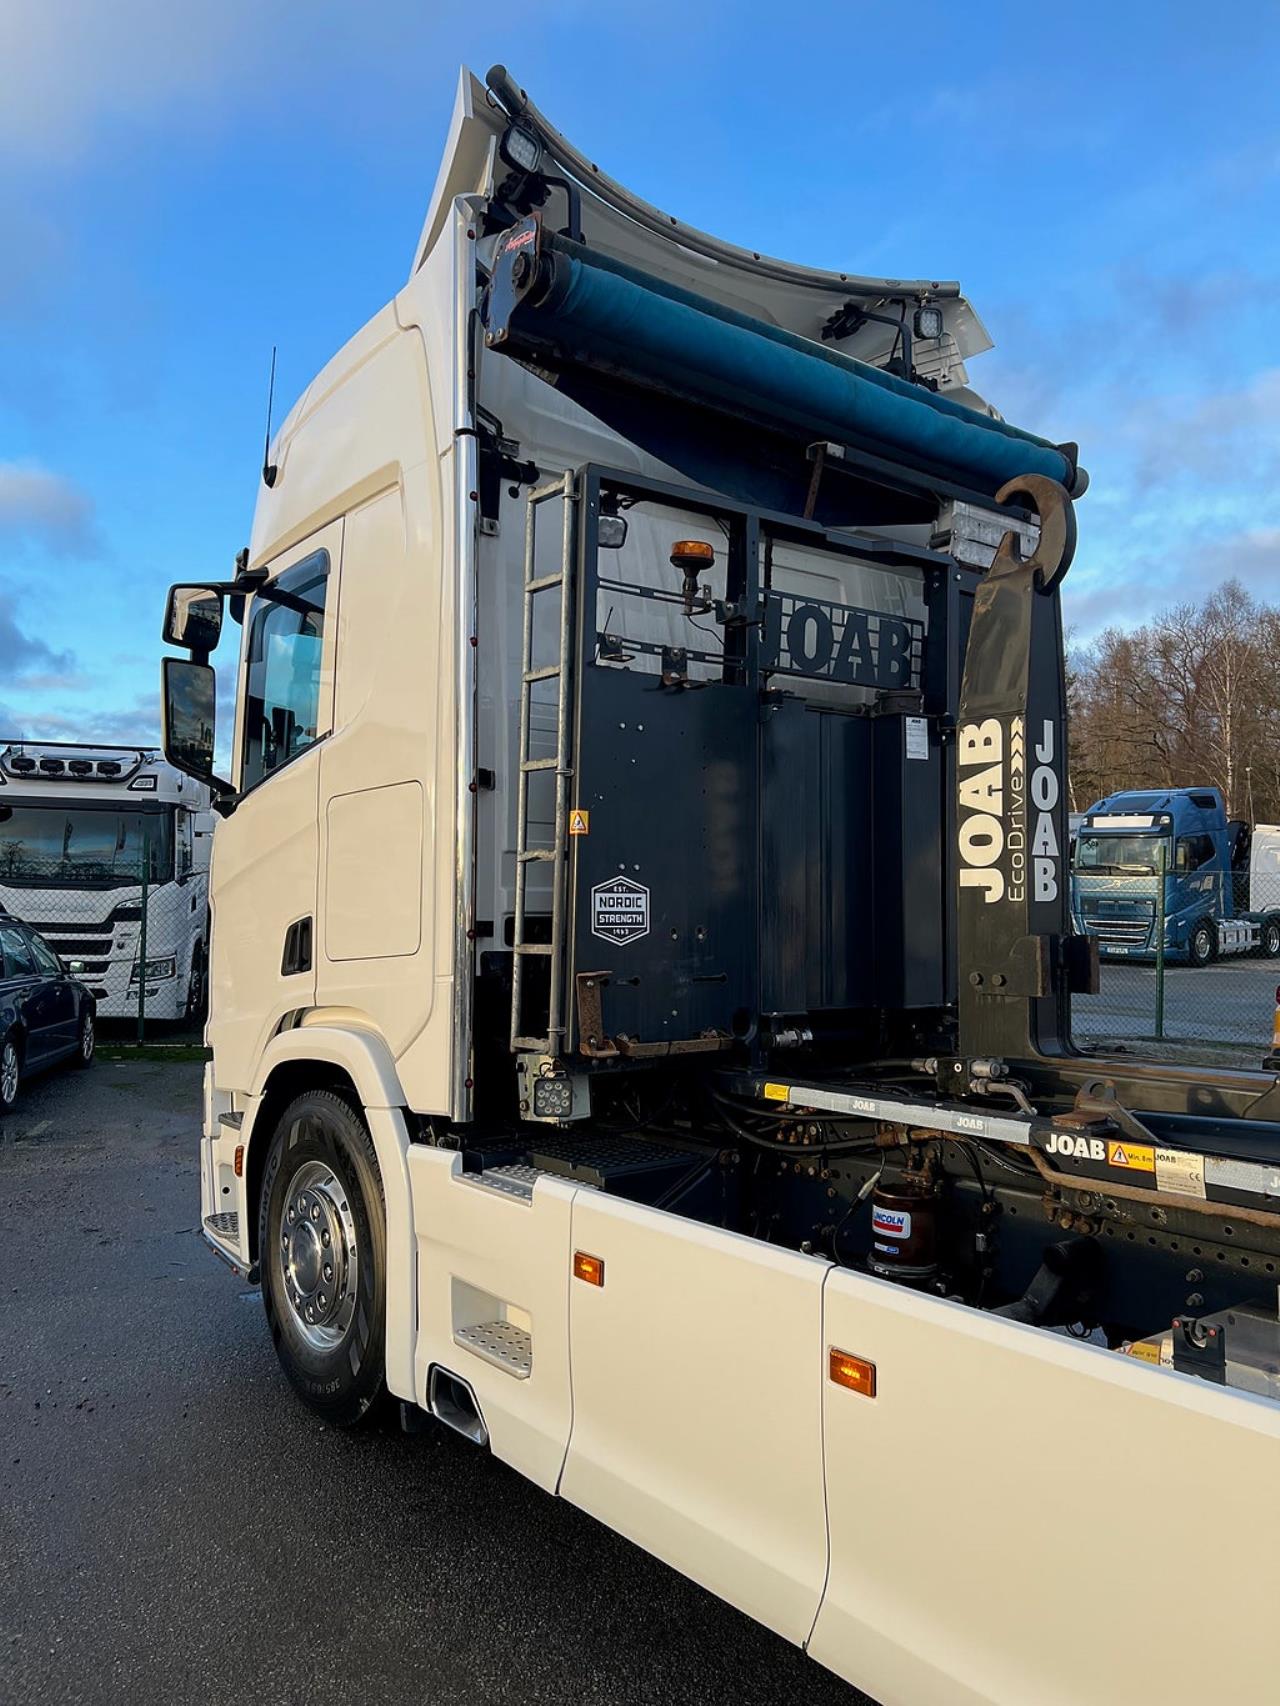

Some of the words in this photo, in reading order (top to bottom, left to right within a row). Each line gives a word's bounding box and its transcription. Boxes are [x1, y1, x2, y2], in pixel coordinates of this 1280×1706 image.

[759, 598, 911, 688] JOAB
[958, 718, 1004, 903] JOAB
[1031, 719, 1060, 902] JOAB
[1008, 775, 1024, 902] EcoDrive
[599, 896, 642, 908] NORDIC
[599, 914, 643, 923] STRENGTH
[852, 1100, 876, 1112] JOAB
[956, 1116, 984, 1131] JOAB
[1045, 1133, 1106, 1161] JOAB
